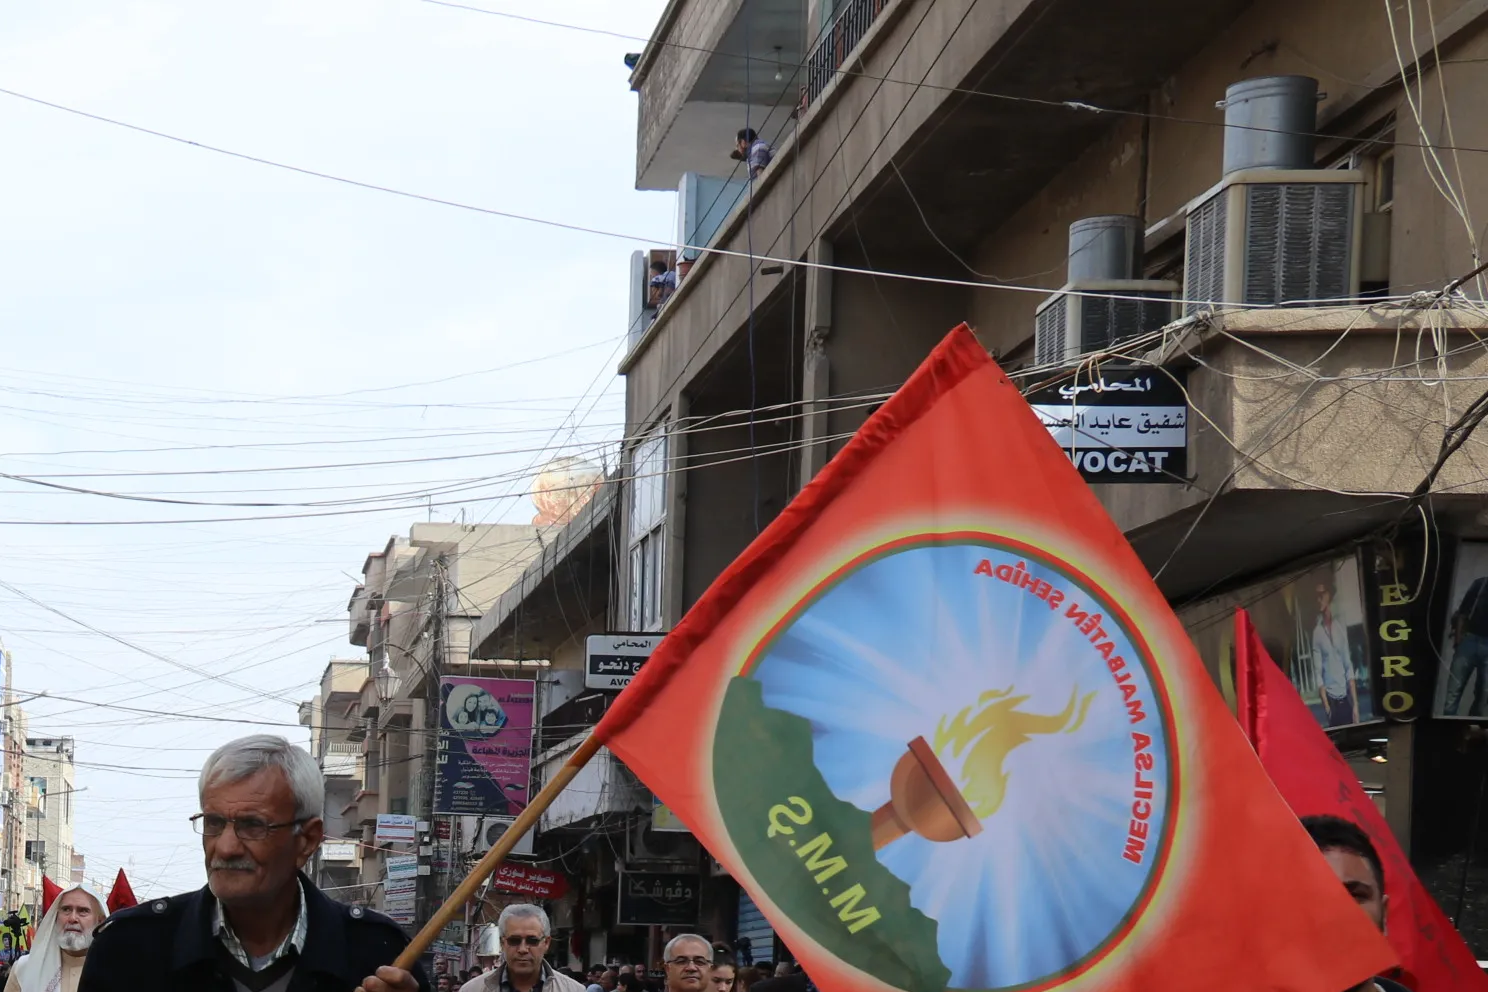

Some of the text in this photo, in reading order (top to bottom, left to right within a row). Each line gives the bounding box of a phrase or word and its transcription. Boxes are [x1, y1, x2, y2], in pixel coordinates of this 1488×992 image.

[1058, 377, 1151, 400] المحامي
[1089, 413, 1132, 435] عايد
[1136, 413, 1185, 434] شفيق
[1065, 451, 1169, 473] VOCAT
[612, 640, 651, 649] المحامي
[1378, 583, 1415, 714] EGRO
